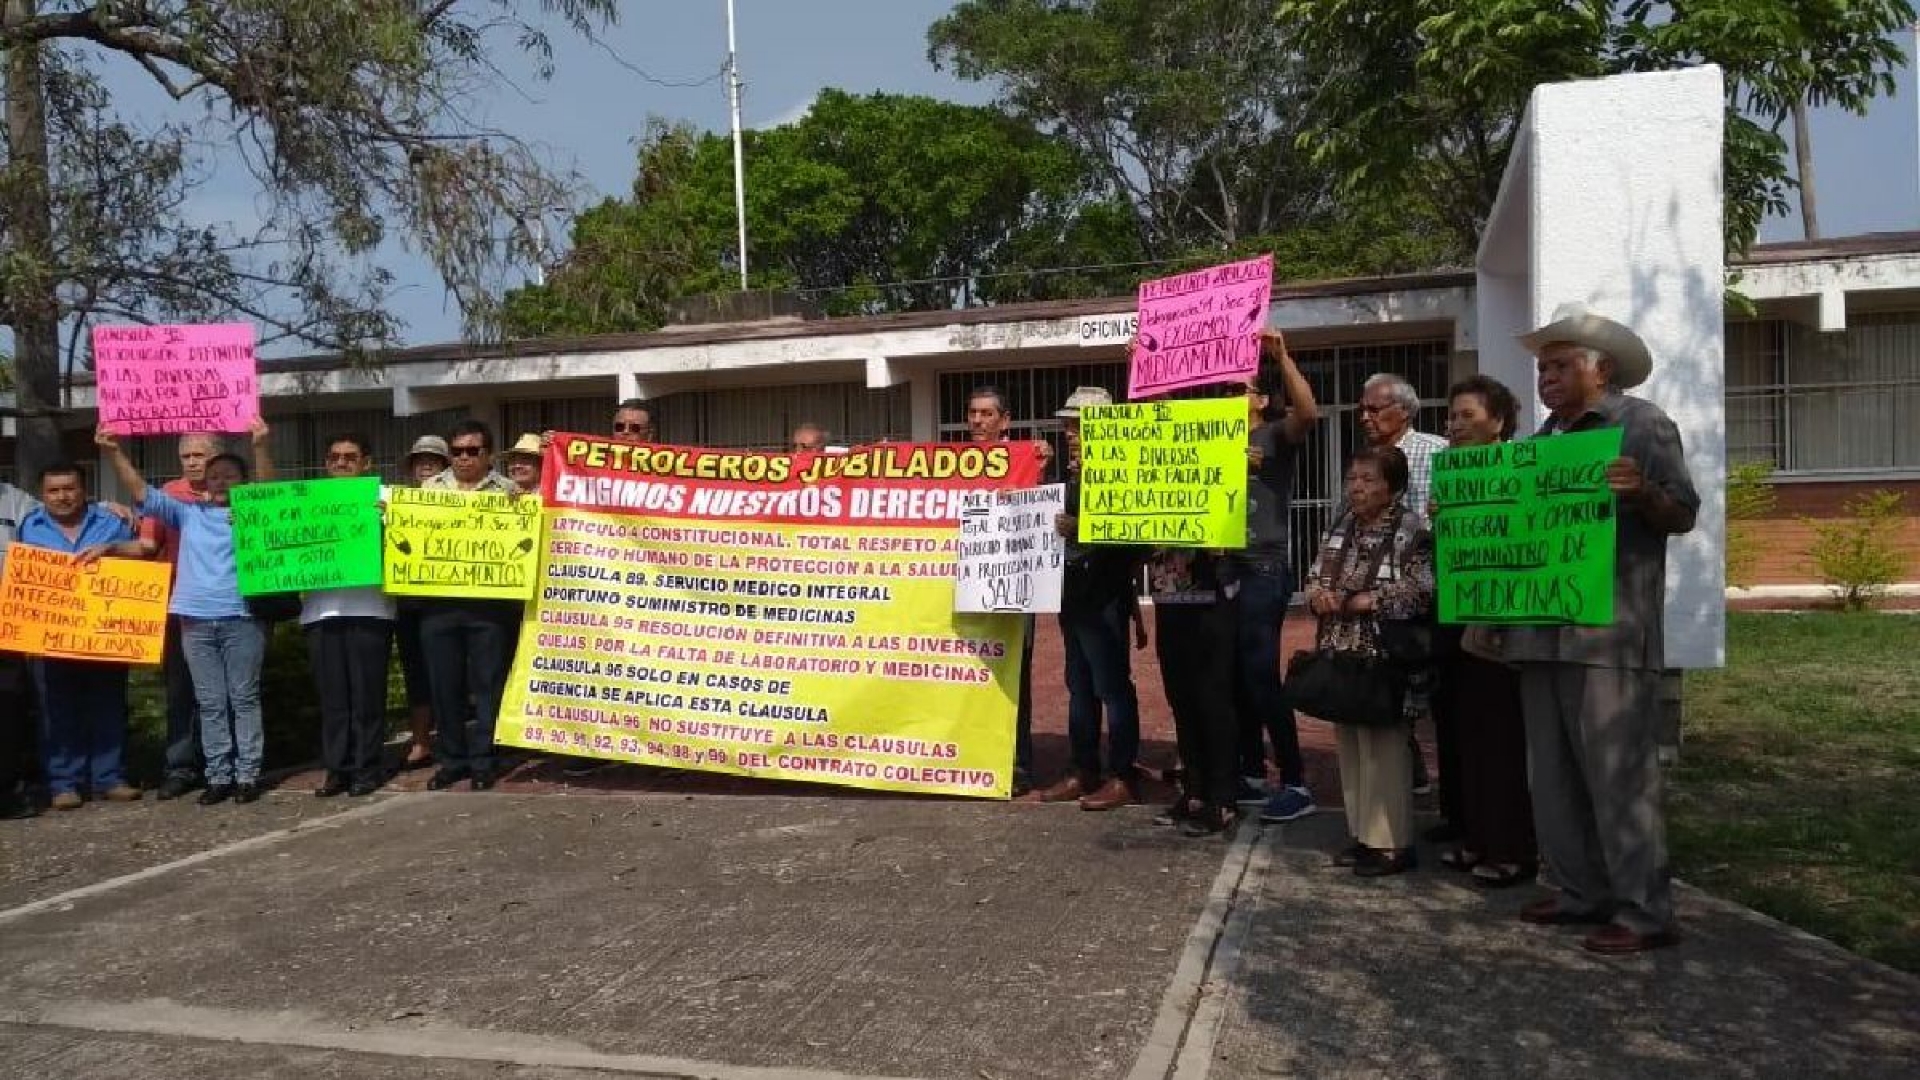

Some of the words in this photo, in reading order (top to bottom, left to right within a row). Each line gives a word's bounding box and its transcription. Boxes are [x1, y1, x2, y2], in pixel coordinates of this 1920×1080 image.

[1081, 319, 1138, 339] OFICINAS
[117, 369, 141, 381] LAS
[155, 369, 220, 383] DIVERSAS
[231, 400, 240, 416] Y
[1084, 406, 1143, 419] CLAUSULA
[568, 440, 790, 482] PETROLEROS
[800, 447, 1009, 482] JUBILADOS
[1085, 445, 1093, 459] A
[1102, 447, 1126, 461] LAS
[1139, 446, 1198, 466] DIVERSAS
[1435, 448, 1503, 472] CLAUSULA
[1512, 443, 1536, 466] 89
[1138, 469, 1160, 484] POR
[1166, 469, 1201, 484] FALTA
[1203, 467, 1224, 485] DE
[1436, 478, 1522, 501] SERVICIO
[556, 475, 687, 510] EXIGIMOS
[688, 487, 842, 518] NUESTROS
[1085, 489, 1209, 512] LABORATORIO
[1226, 490, 1237, 513] Y
[554, 518, 626, 536] ARTICULO
[632, 528, 637, 536] 4
[642, 527, 791, 548] CONSTITUCIONAL.
[797, 536, 850, 550] TOTAL
[858, 538, 936, 552] RESPETO
[1526, 512, 1536, 531] Y
[551, 541, 619, 560] DERECHO
[624, 549, 688, 565] HUMANO
[694, 553, 713, 566] DE
[720, 555, 740, 568] LA
[745, 556, 860, 576] PROTECCION
[864, 562, 875, 575] A
[880, 563, 900, 576] LA
[1560, 532, 1586, 563] DE
[8, 586, 87, 611] INTEGRAL
[105, 600, 112, 612] Y
[548, 565, 621, 581] CLAUSULA
[626, 572, 648, 586] 89.
[655, 575, 728, 592] SERVICIO
[733, 579, 800, 594] MEDICO
[807, 584, 891, 602] INTEGRAL
[1455, 575, 1583, 616] MEDICINAS
[544, 587, 620, 604] OPORTUNO
[625, 595, 730, 616] SUMINISTRO
[736, 604, 757, 619] DE
[764, 607, 855, 623] MEDICINAS
[2, 623, 21, 640] DE
[541, 611, 608, 626] CLAUSULA
[614, 616, 634, 629] 95
[753, 628, 845, 648] DEFINITIVA
[852, 636, 863, 649] A
[868, 637, 900, 650] LAS
[907, 638, 1004, 657] DIVERSAS
[538, 634, 586, 649] QUEJAS
[595, 638, 624, 652] POR
[629, 643, 650, 656] LA
[658, 645, 706, 662] FALTA
[712, 650, 735, 664] DE
[741, 653, 860, 674] LABORATORIO
[866, 660, 876, 674] Y
[883, 663, 990, 683] MEDICINAS
[533, 656, 600, 674] CLAUSULA
[605, 662, 622, 677] 96
[627, 666, 672, 682] SOLO
[677, 672, 699, 685] EN
[706, 674, 763, 692] CASOS
[768, 681, 791, 695] DE
[529, 680, 597, 698] URGENCIA
[602, 687, 621, 701] SE
[625, 691, 683, 708] APLICA
[689, 697, 731, 713] ESTA
[739, 700, 828, 722] CLAUSULA
[525, 703, 543, 717] LA
[549, 705, 619, 725] CLAUSULA
[624, 715, 639, 728] 96
[649, 717, 671, 732] NO
[677, 720, 774, 743] SUSTITUYE
[784, 732, 796, 746] A
[803, 732, 838, 748] LAS
[845, 735, 957, 758] CLAUSULAS
[595, 736, 614, 752] 92,
[621, 739, 640, 754] 93,
[695, 752, 704, 763] y
[709, 749, 726, 763] 99
[738, 754, 771, 766] DEL
[779, 754, 877, 777] CONTRATO
[884, 766, 994, 787] COLECTIVO
